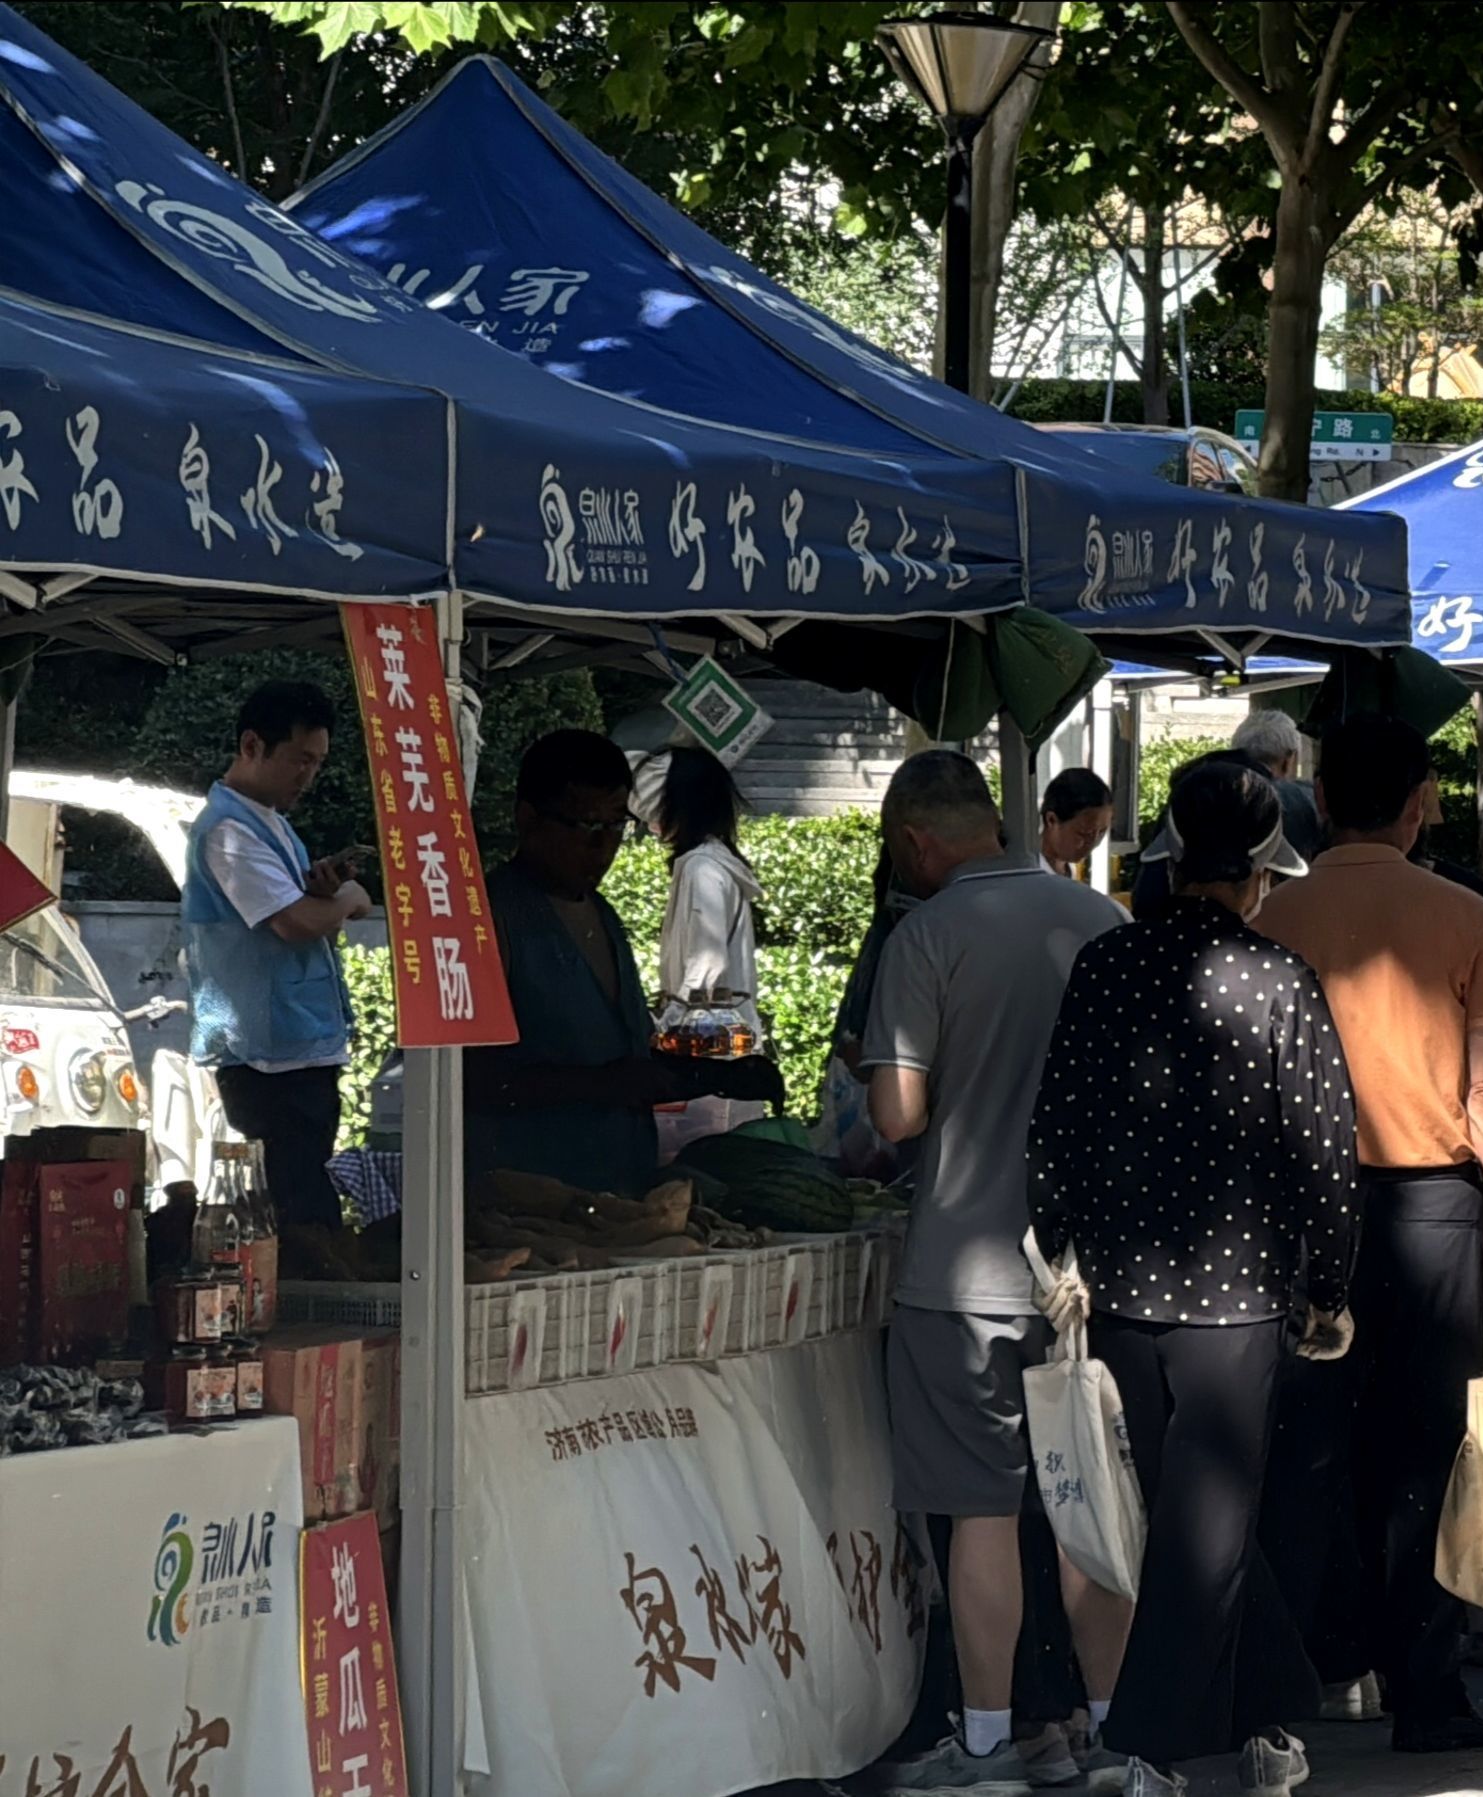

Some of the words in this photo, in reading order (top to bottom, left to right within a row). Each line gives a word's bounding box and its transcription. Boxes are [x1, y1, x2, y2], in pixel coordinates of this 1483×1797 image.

[512, 321, 558, 335] JIA
[669, 480, 820, 595] 好农品
[1167, 517, 1269, 613] 好农品
[361, 656, 422, 985] 山东省老字号
[375, 623, 474, 1021] 莱芜香肠
[428, 694, 487, 954] 非物质文化遗产
[312, 1616, 334, 1797] 沂蒙山
